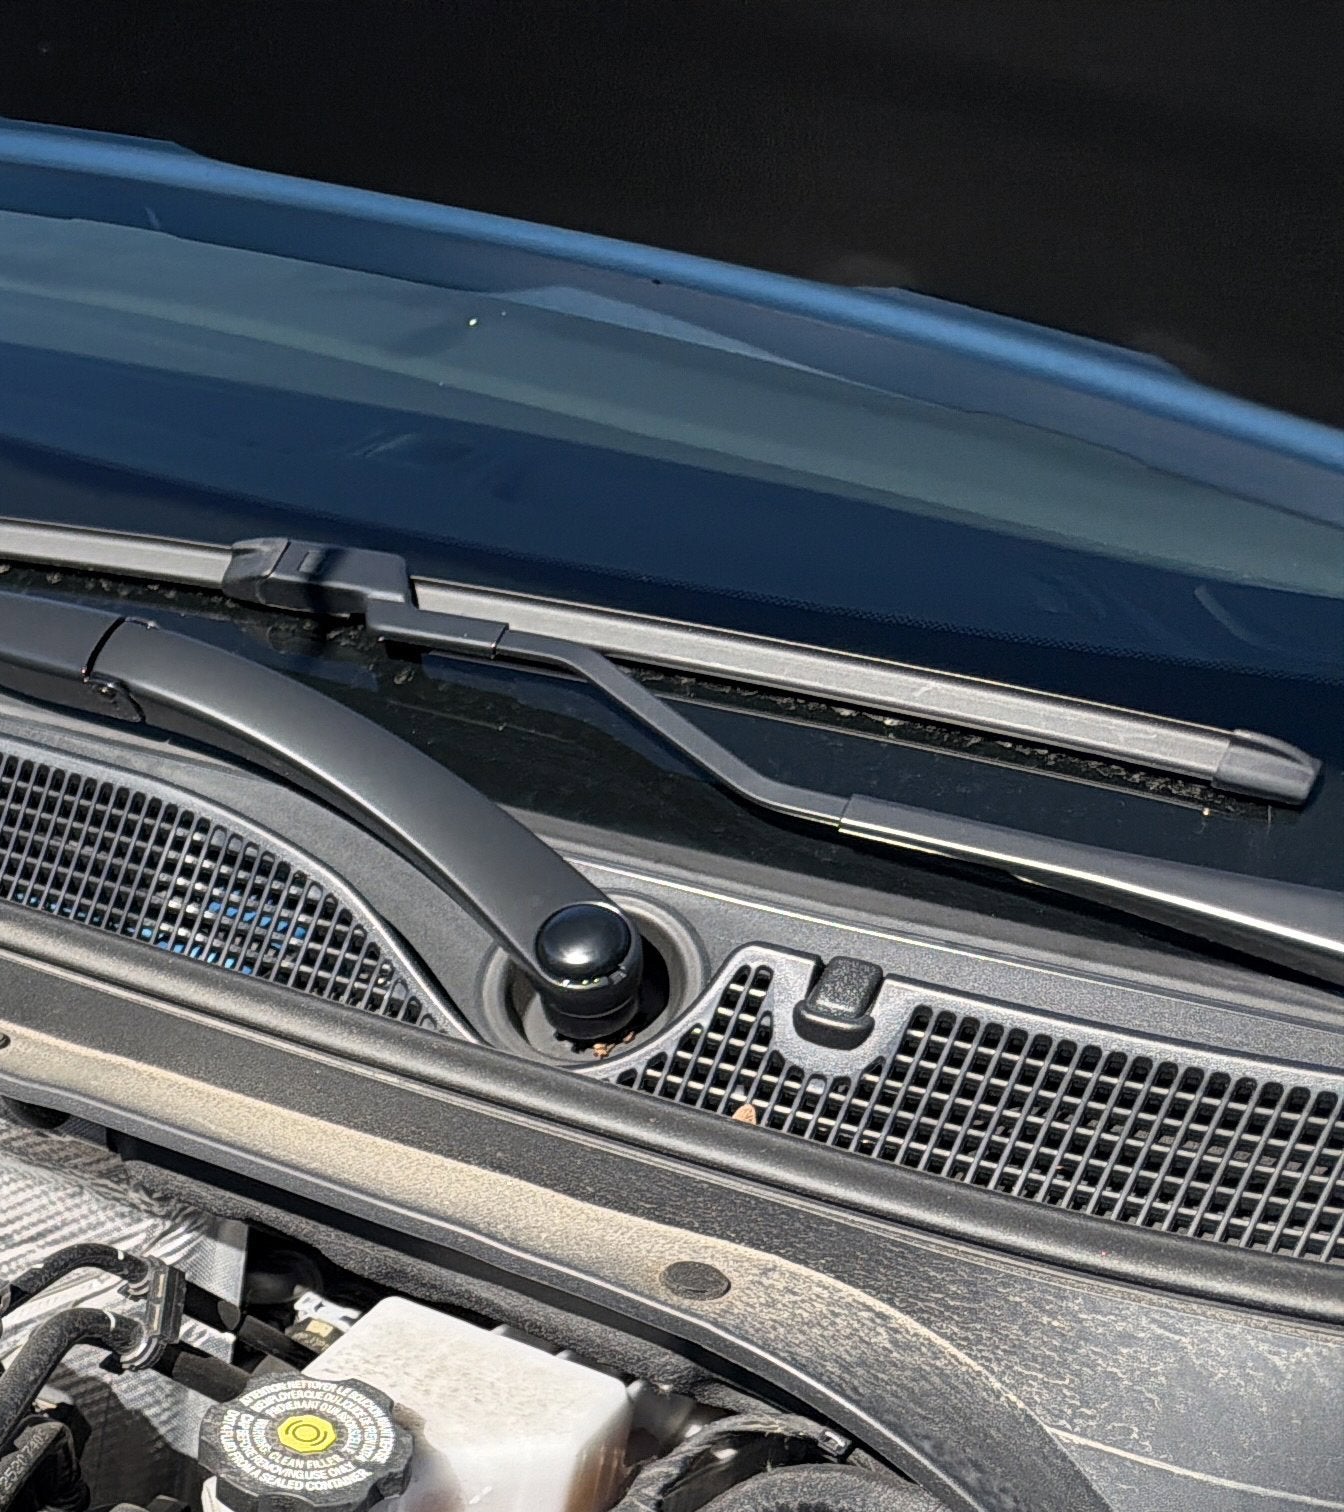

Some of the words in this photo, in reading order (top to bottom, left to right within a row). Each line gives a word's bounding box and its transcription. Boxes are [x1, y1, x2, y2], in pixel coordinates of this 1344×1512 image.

[228, 1451, 255, 1473] FROM
[259, 1473, 304, 1490] SEALED
[236, 1430, 258, 1457] BEFORE
[251, 1455, 304, 1479] REMOVING
[305, 1470, 328, 1480] USE
[328, 1462, 355, 1477] ONLY
[269, 1452, 304, 1468] CLEAN
[307, 1455, 344, 1469] FILLER
